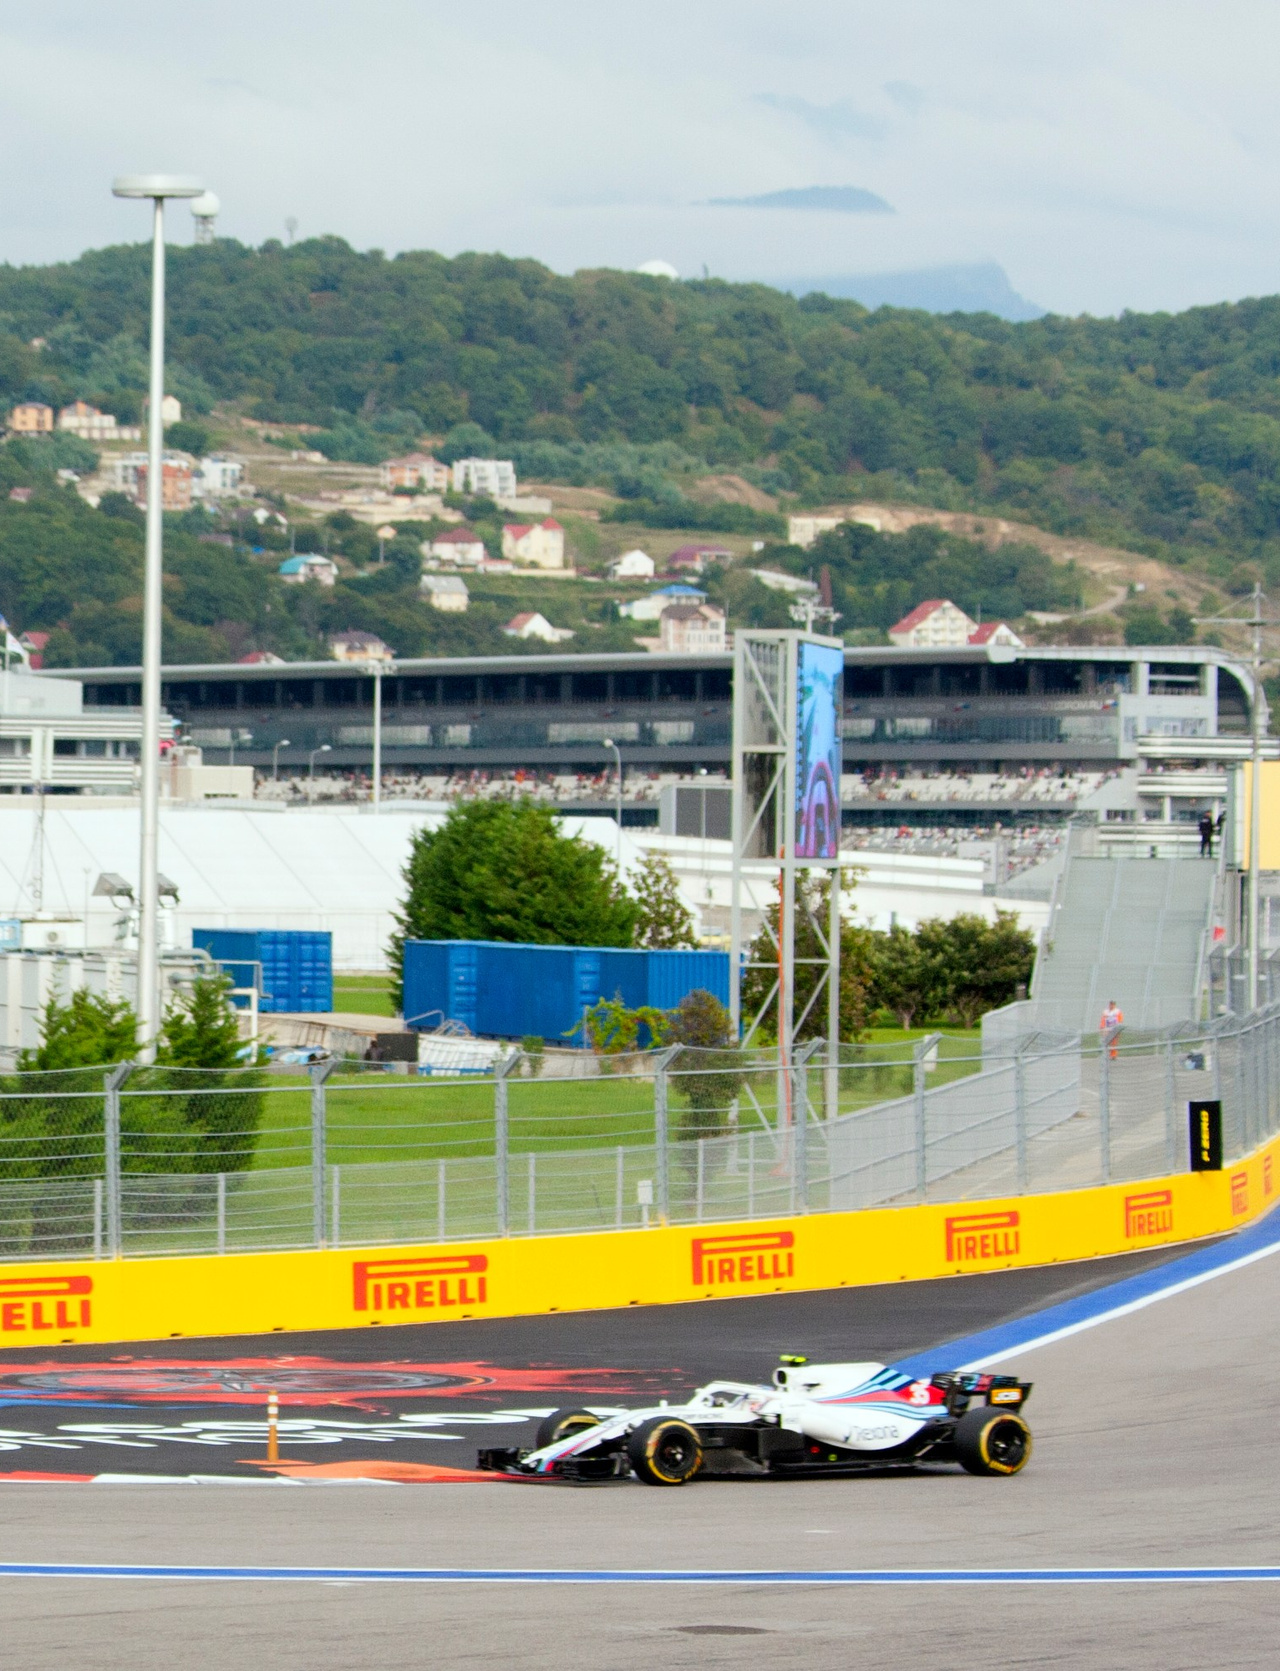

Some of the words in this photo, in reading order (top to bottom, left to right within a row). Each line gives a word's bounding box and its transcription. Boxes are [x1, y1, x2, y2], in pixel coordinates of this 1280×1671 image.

[946, 1213, 1019, 1262] PIRELLI
[1125, 1190, 1173, 1238] PIRELLI
[352, 1255, 488, 1310] PIRELLI
[692, 1231, 794, 1285] PIRELLI
